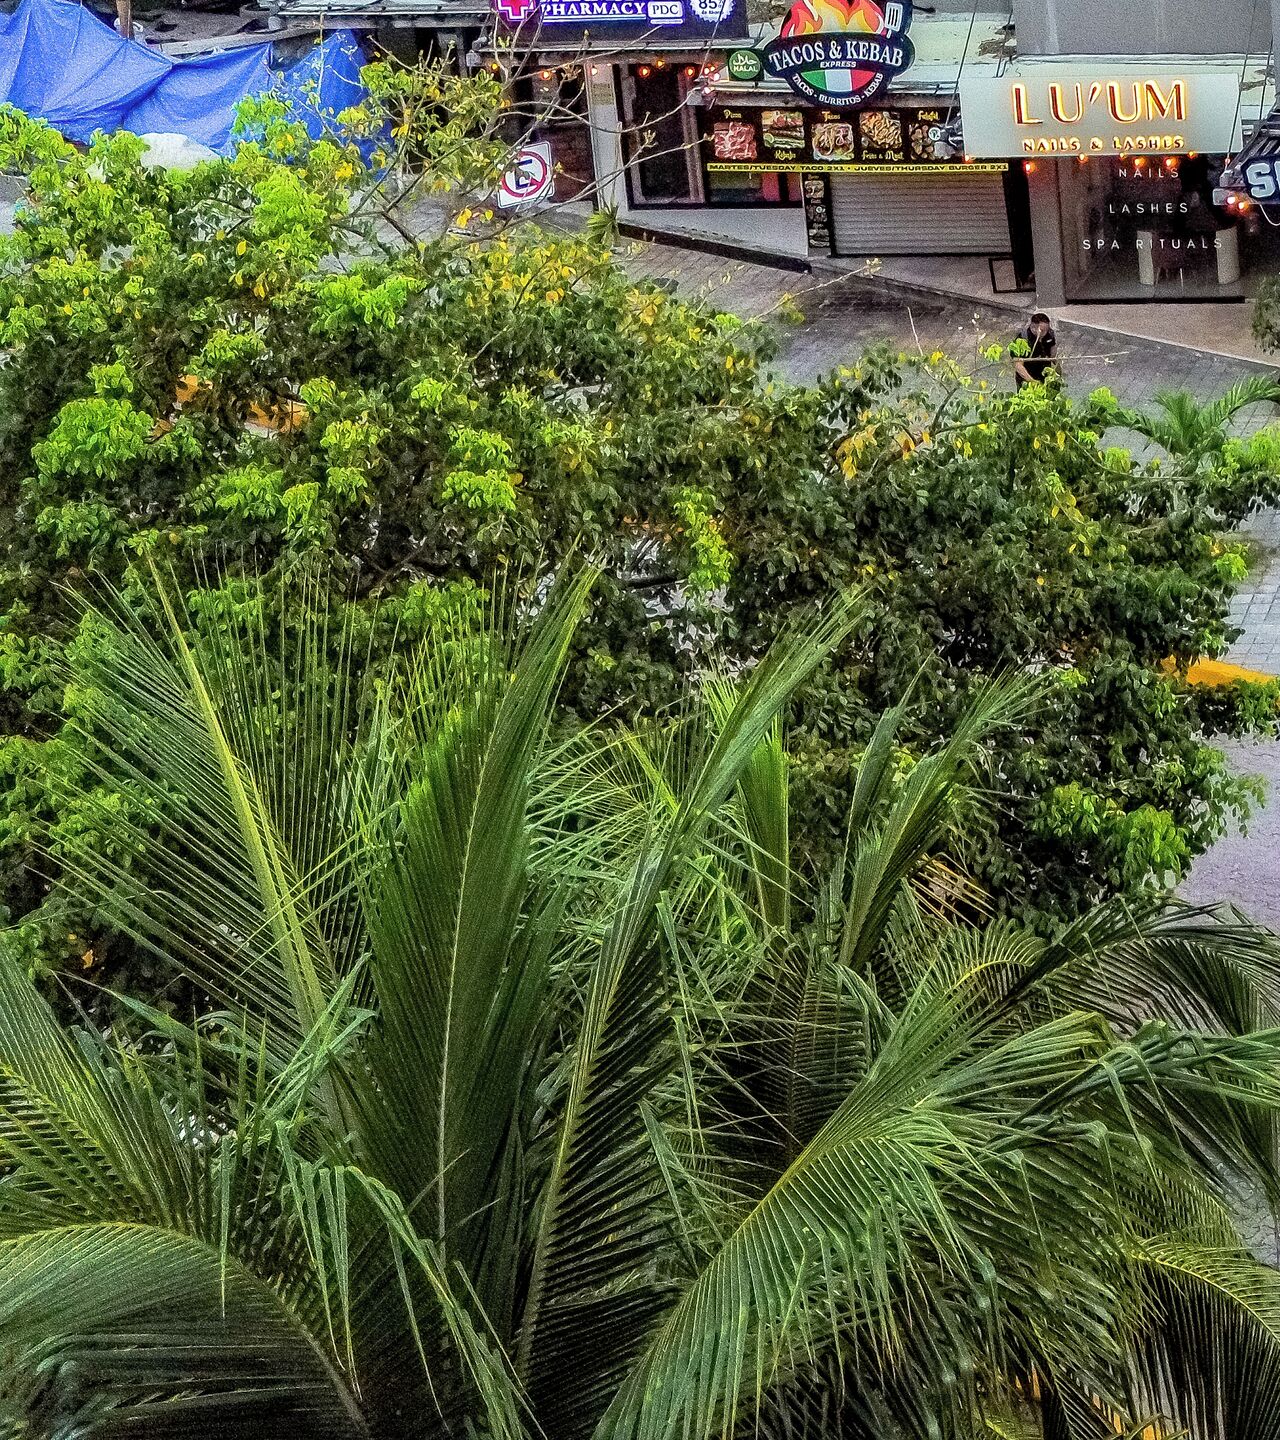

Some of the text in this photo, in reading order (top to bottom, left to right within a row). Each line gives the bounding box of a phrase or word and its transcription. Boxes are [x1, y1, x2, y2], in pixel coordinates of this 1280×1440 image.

[541, 1, 646, 16] PHARMACY
[651, 4, 680, 16] PDC
[768, 39, 904, 72] TACOS & KEBAB
[819, 61, 857, 69] EXPRESS
[791, 72, 885, 107] TACOS BURRITOS KEBAB
[1022, 135, 1185, 152] NAILS & LASHES
[853, 164, 946, 172] JUEVES/THURSDAY
[1118, 167, 1180, 179] NAILS
[1108, 202, 1189, 215] LASHES
[1081, 237, 1223, 251] SPA RITUALS
